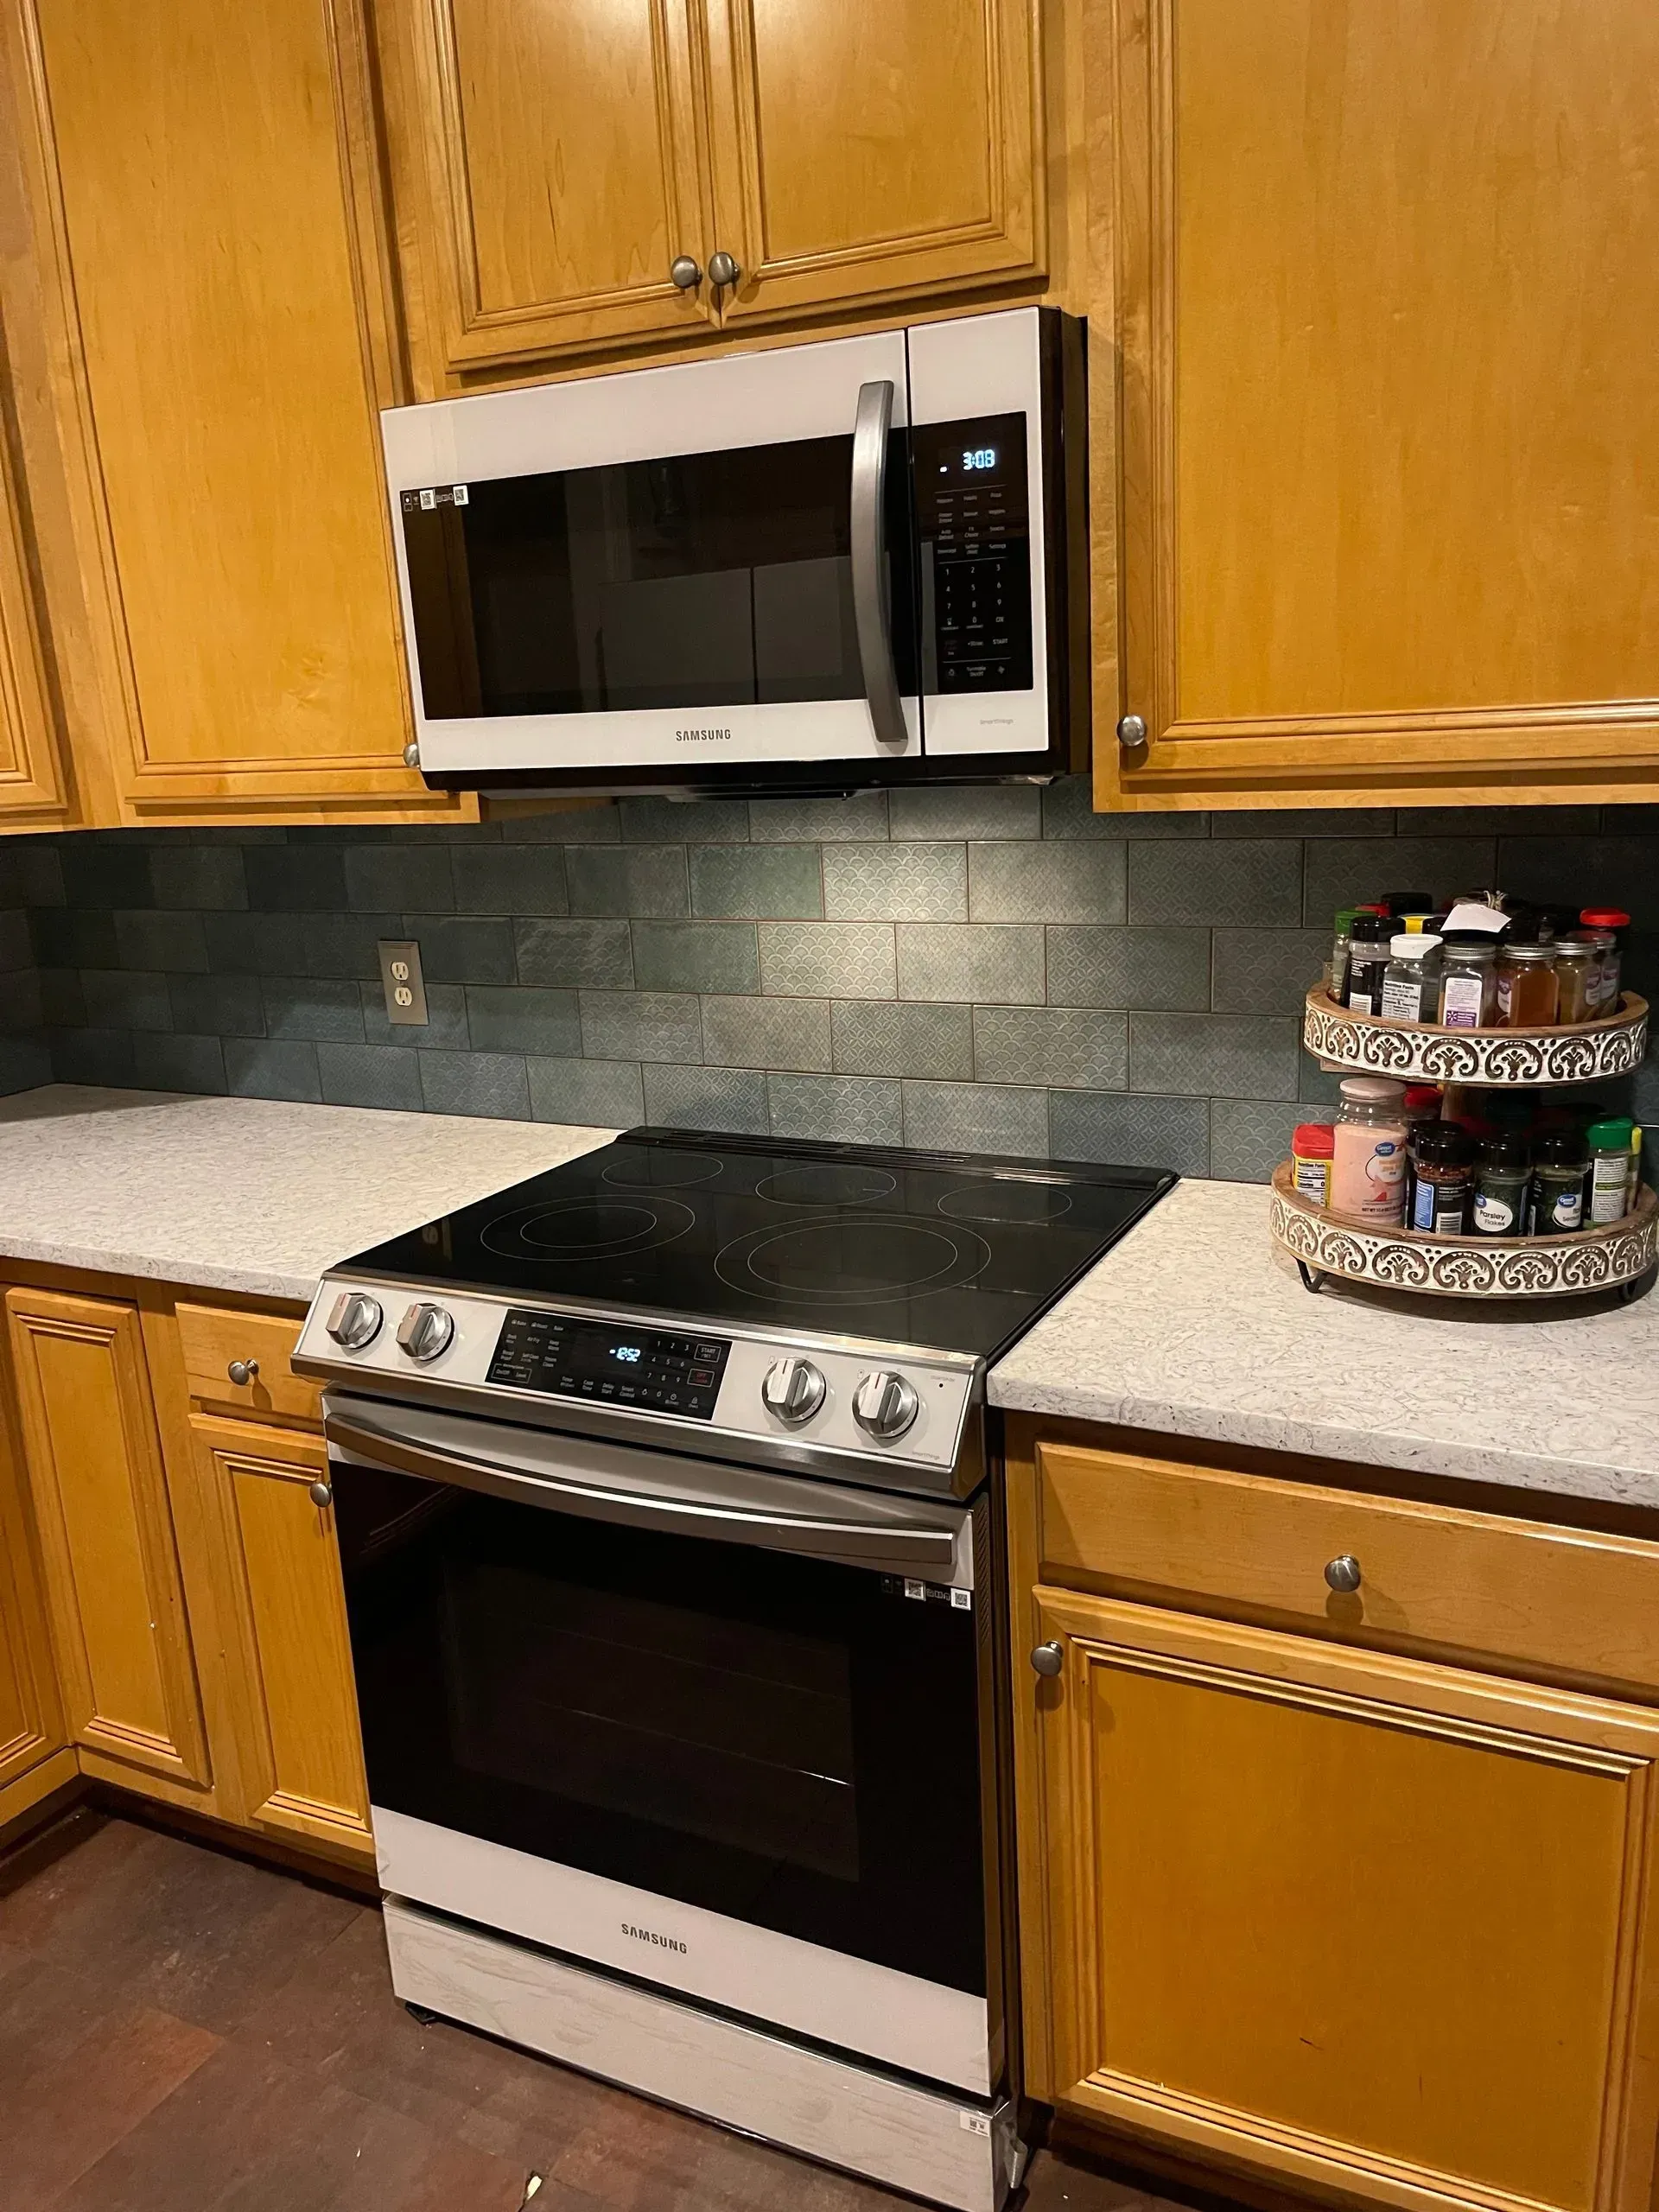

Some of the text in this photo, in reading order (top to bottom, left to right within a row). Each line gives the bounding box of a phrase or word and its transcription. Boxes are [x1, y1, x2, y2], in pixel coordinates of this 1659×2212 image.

[963, 449, 995, 471] 3:08
[676, 729, 731, 741] SAMSUNG
[1479, 1210, 1505, 1221] Parsley
[621, 1923, 687, 1955] SAMSUNG
